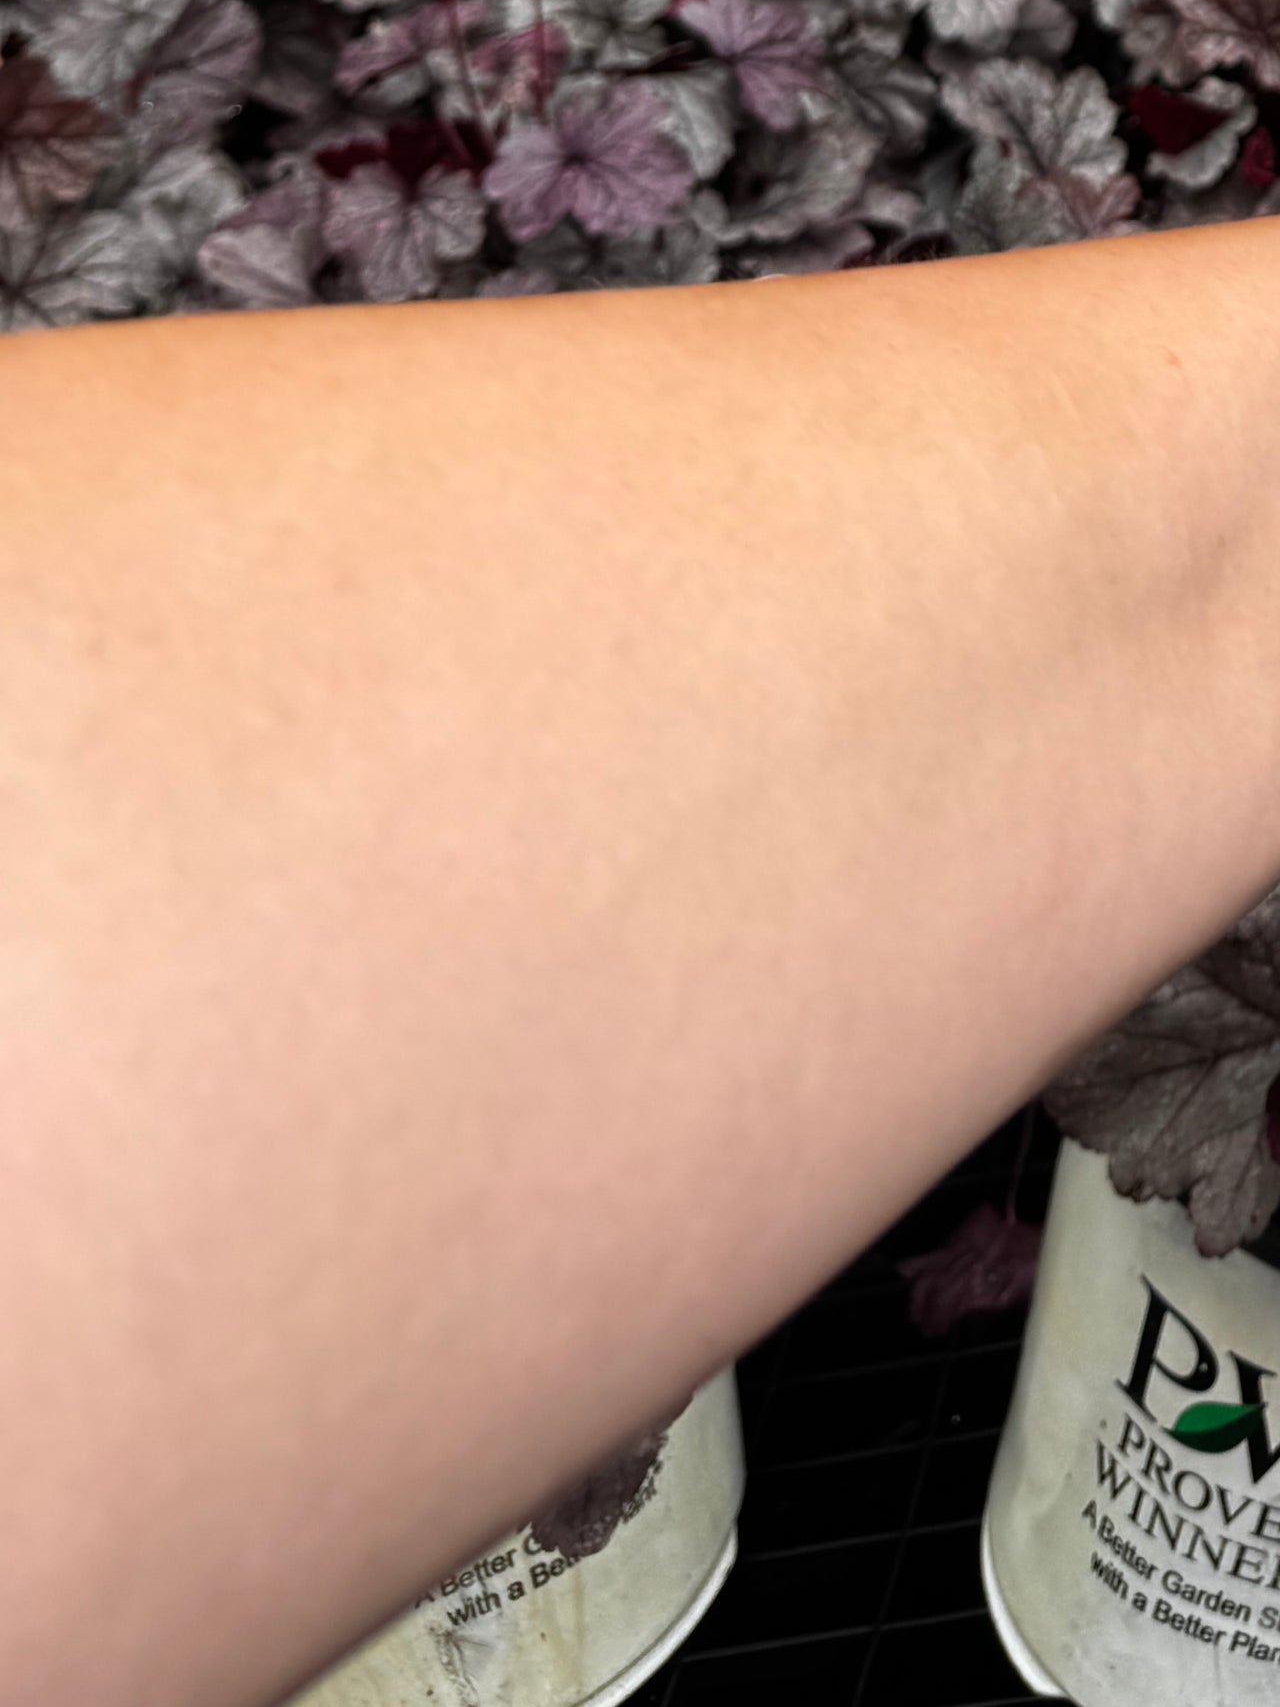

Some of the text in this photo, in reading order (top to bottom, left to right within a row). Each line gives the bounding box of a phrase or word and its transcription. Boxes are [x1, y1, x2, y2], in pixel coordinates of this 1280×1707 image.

[446, 1589, 501, 1627] with
[506, 1581, 526, 1601] a
[1081, 1499, 1098, 1532] A
[1097, 1515, 1159, 1581] Better
[1161, 1568, 1252, 1623] Garden
[1091, 1551, 1129, 1602] with
[1132, 1590, 1147, 1612] a
[1152, 1601, 1226, 1647] Better
